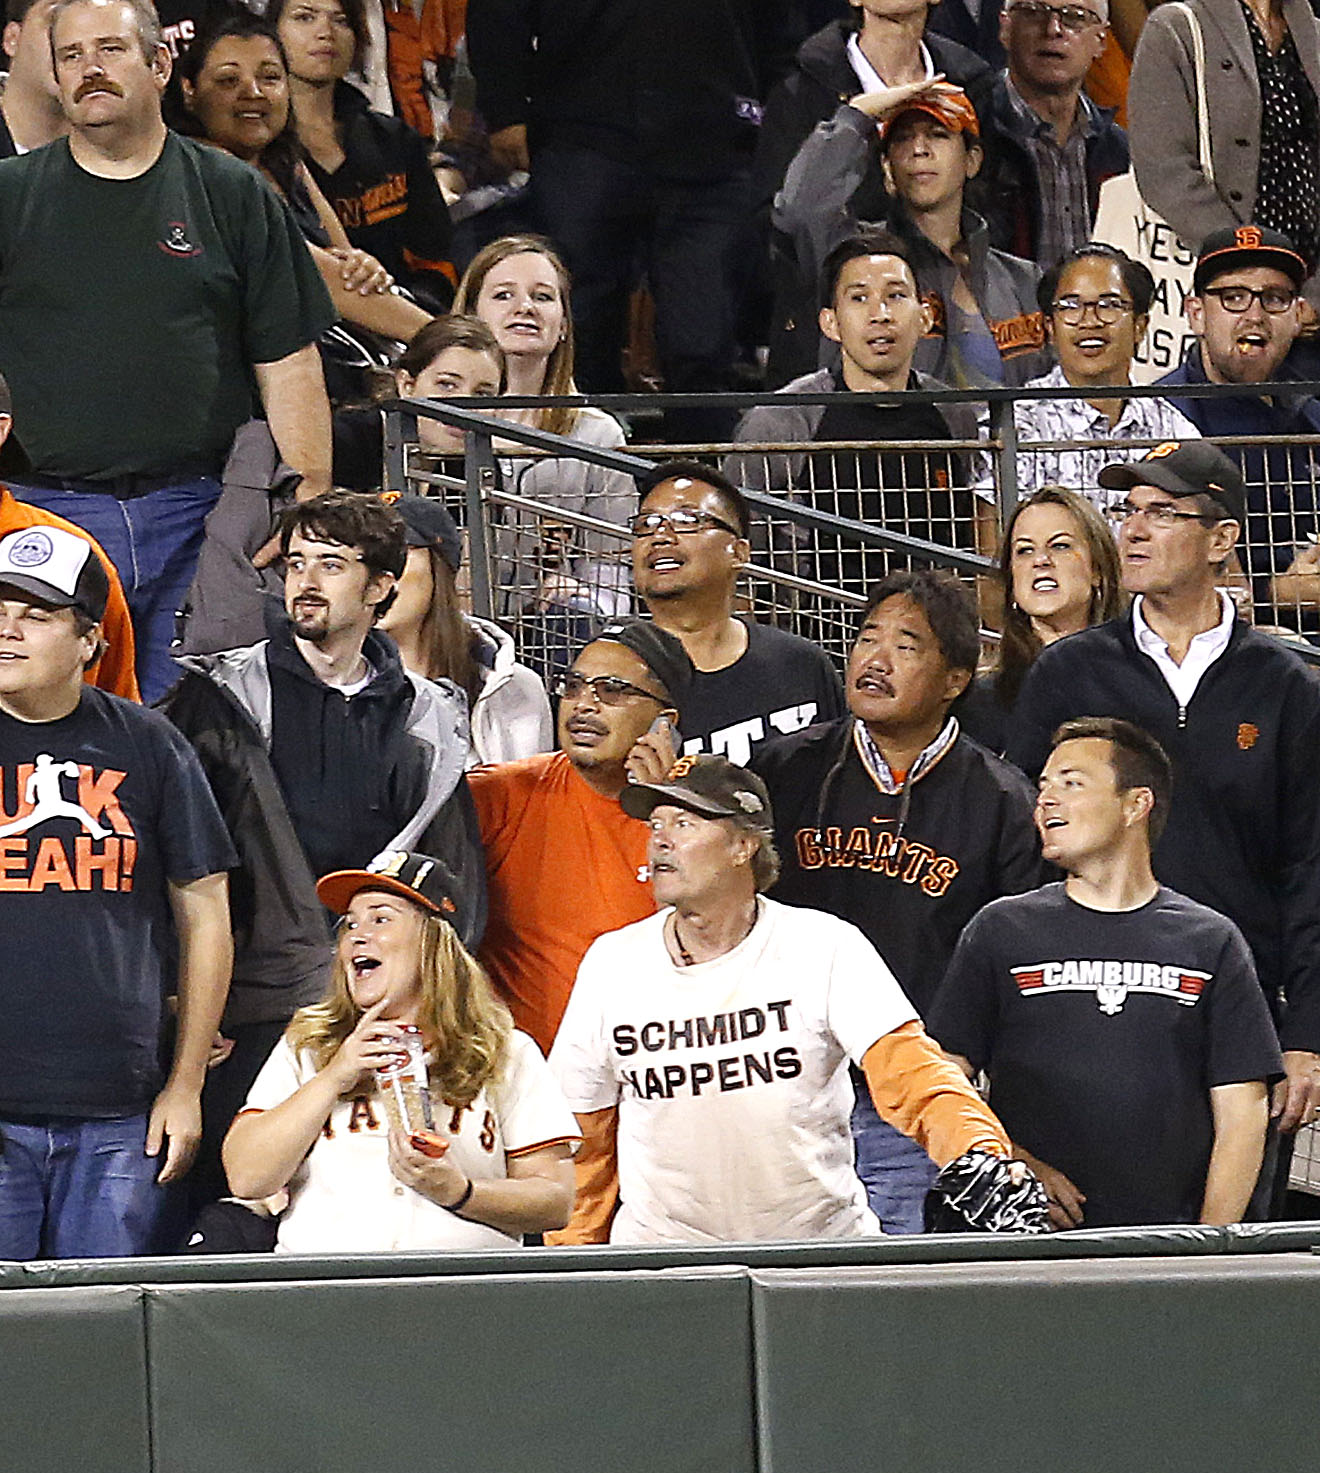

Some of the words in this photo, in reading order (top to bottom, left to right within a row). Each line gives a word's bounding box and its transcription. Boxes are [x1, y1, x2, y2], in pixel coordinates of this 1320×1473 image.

[794, 826, 960, 898] GIANTS
[1042, 959, 1183, 991] CAMBURG
[612, 999, 793, 1057] SCHMIDT
